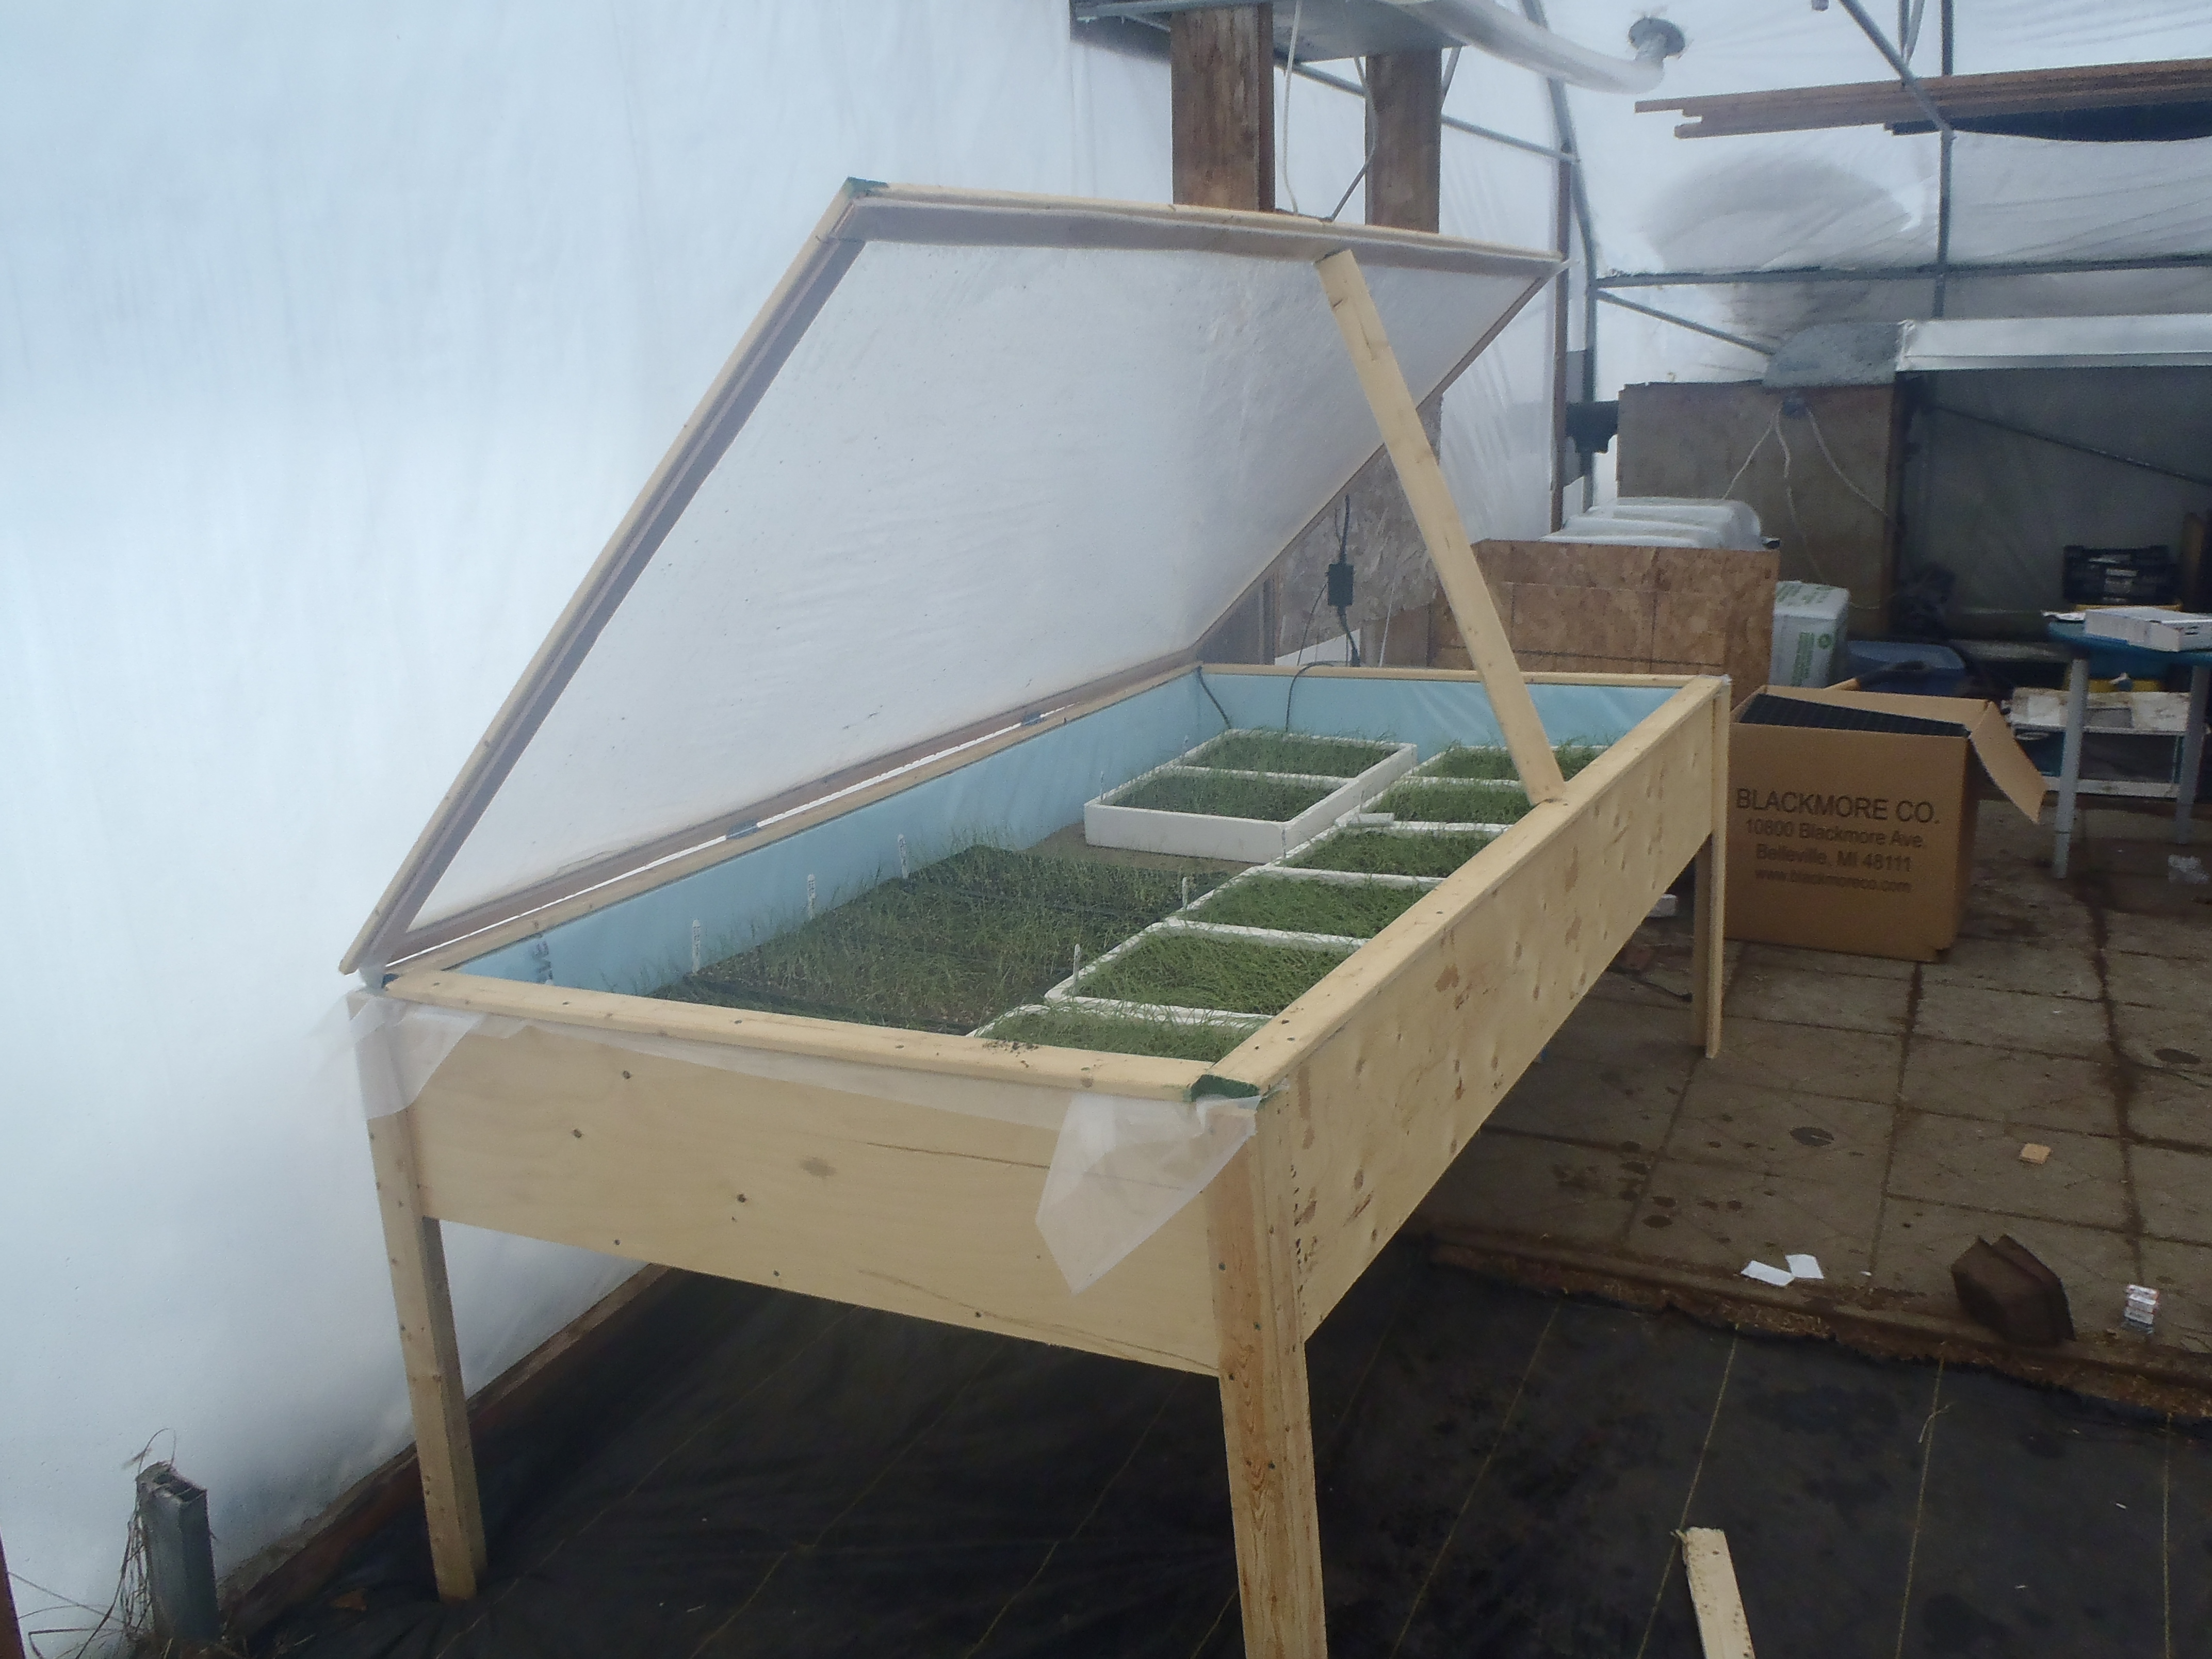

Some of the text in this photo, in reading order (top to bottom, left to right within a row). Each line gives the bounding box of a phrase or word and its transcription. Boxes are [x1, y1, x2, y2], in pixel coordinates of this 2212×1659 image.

[1737, 788, 1940, 824] BLACKMORE CO.
[1799, 823, 1886, 845] Blackmore
[1837, 851, 1858, 867] MI
[1863, 853, 1911, 872] 48111
